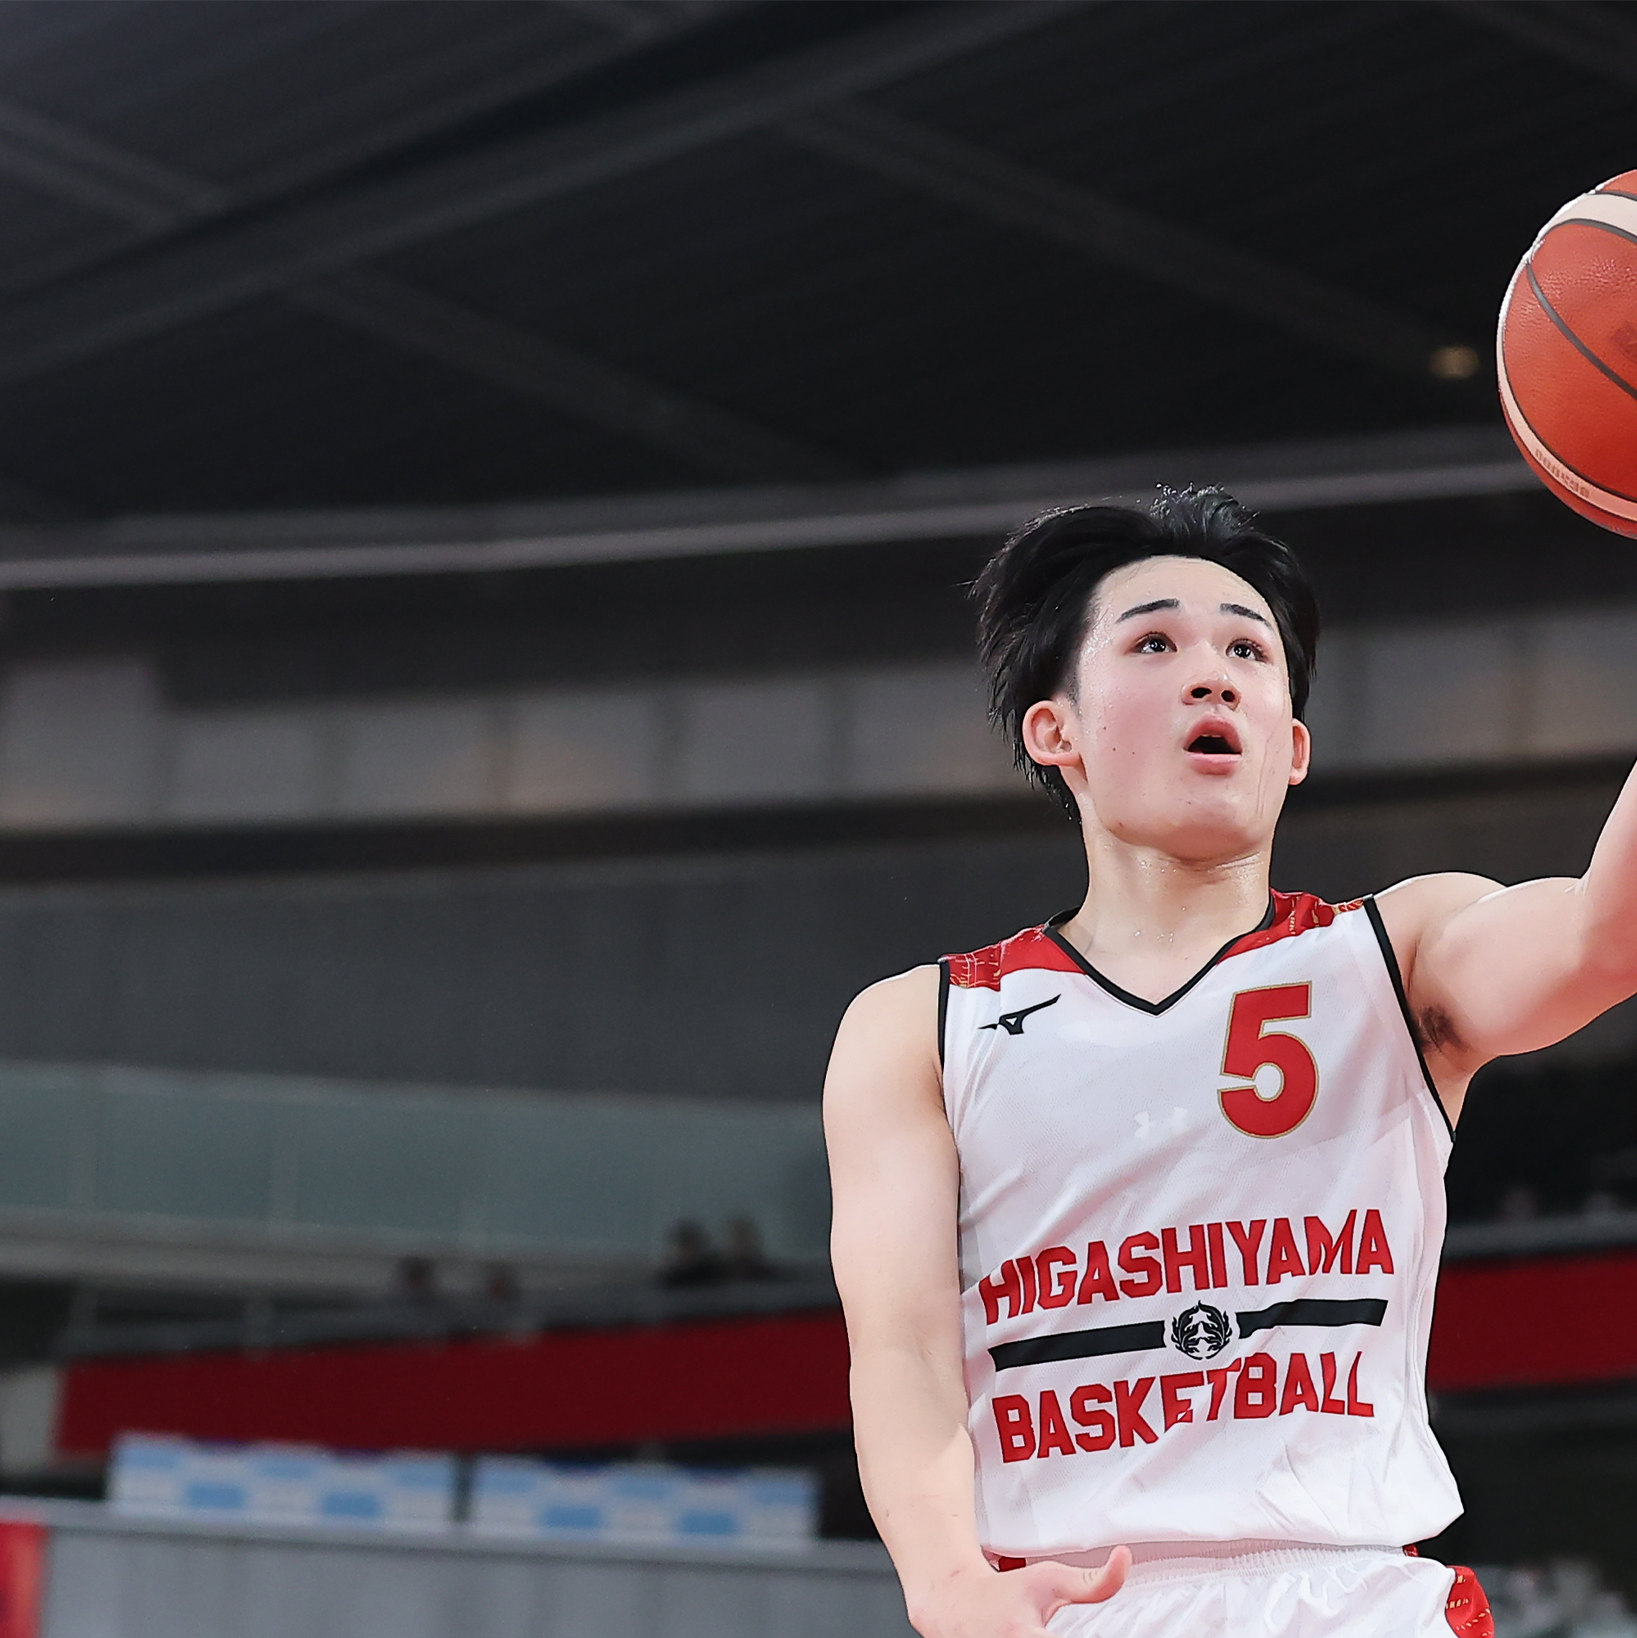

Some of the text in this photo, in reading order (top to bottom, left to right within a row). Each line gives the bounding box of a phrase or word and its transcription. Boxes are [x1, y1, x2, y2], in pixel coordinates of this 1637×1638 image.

[1218, 981, 1319, 1139] 5
[979, 1208, 1395, 1325] HIGASHIYAMA
[992, 1350, 1375, 1464] BASKETBALL
